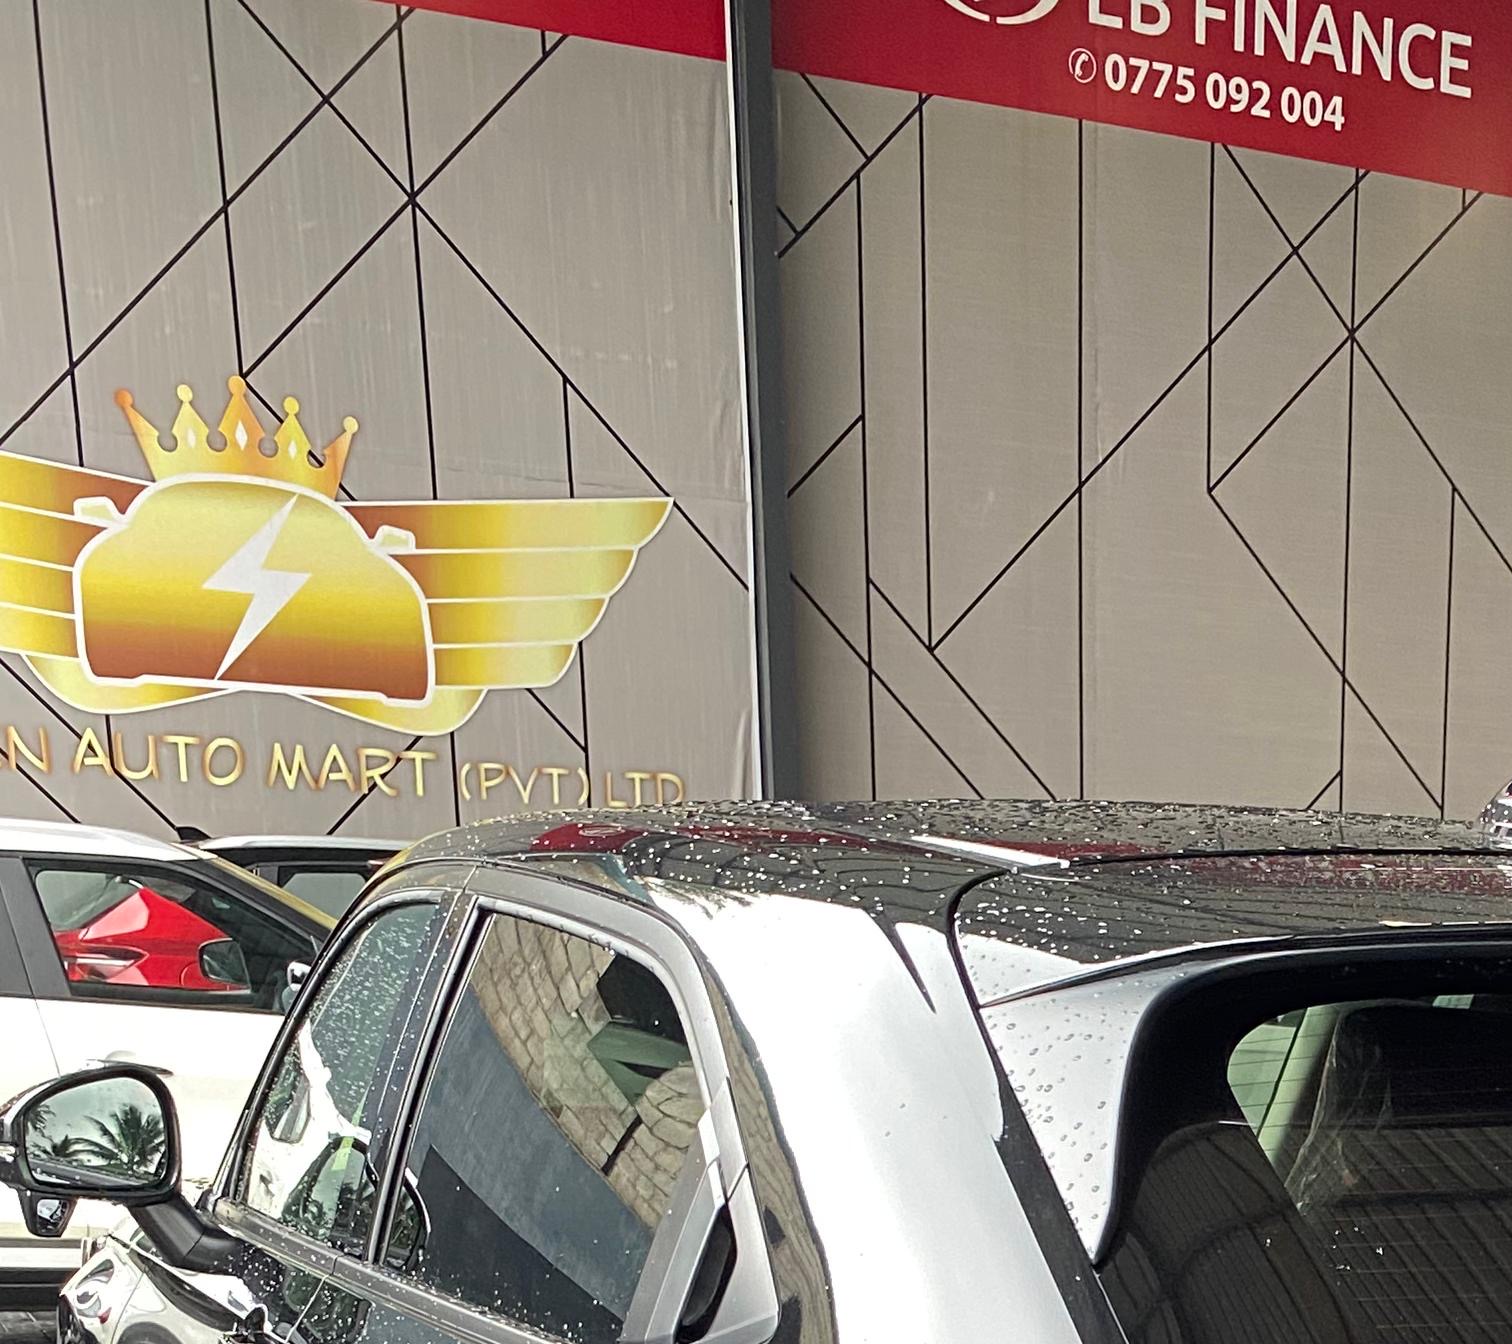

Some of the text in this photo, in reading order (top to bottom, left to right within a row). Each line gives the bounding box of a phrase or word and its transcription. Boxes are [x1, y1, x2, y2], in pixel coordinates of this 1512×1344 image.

[1195, 0, 1472, 98] FINANCE
[1104, 53, 1345, 131] 0775 092 004
[0, 724, 686, 808] N AUTO MART (PVT) LTD
